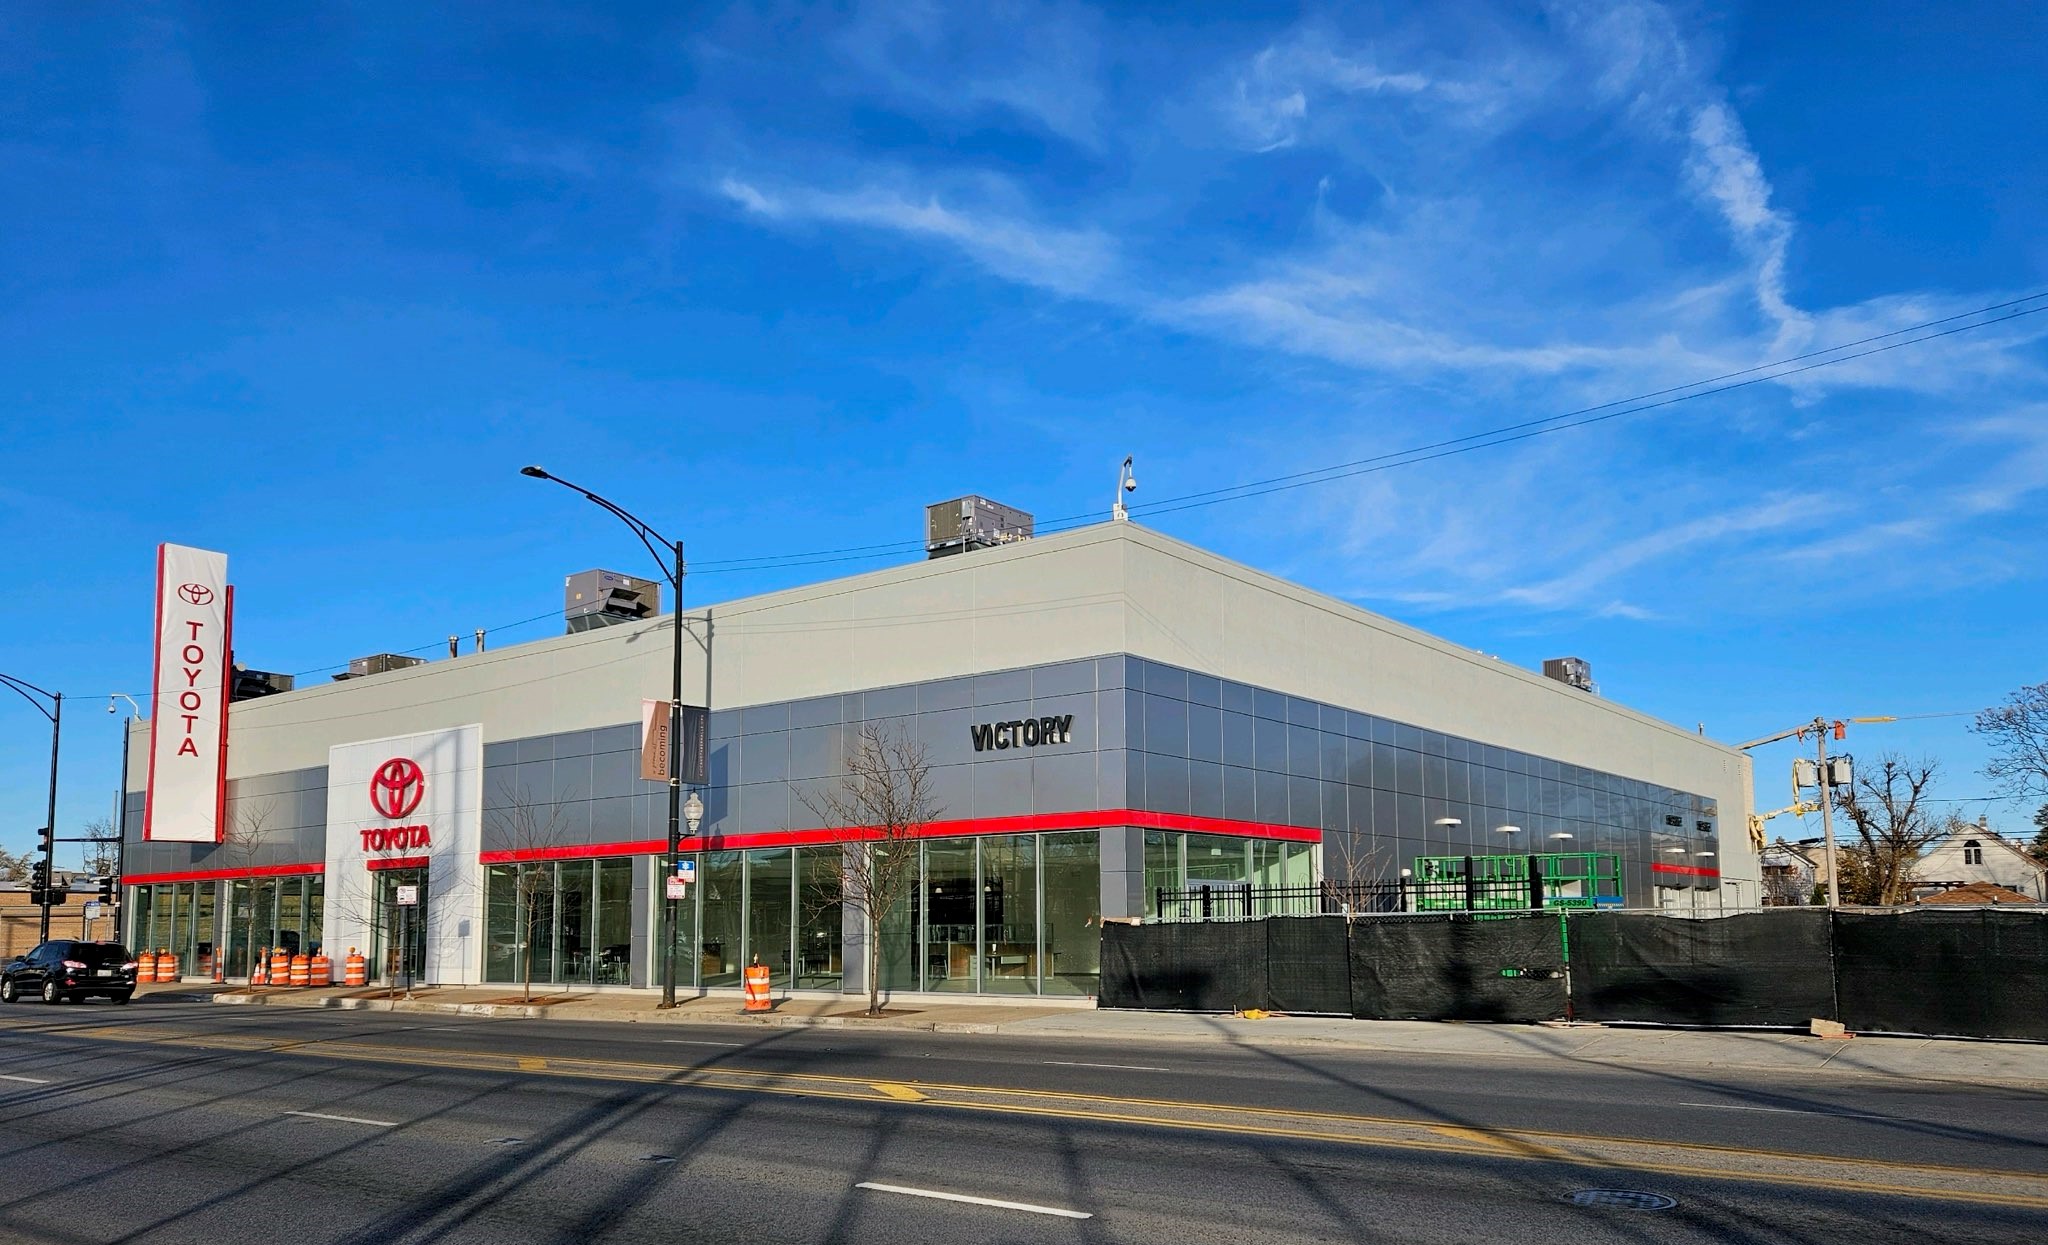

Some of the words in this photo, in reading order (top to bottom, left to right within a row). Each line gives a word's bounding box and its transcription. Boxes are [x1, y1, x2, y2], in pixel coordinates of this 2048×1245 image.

[177, 620, 204, 758] TOYOTA
[658, 725, 668, 776] becoming
[971, 714, 1073, 752] VICTORY
[360, 824, 432, 852] TOYOTA
[1553, 899, 1588, 907] GS-5390
